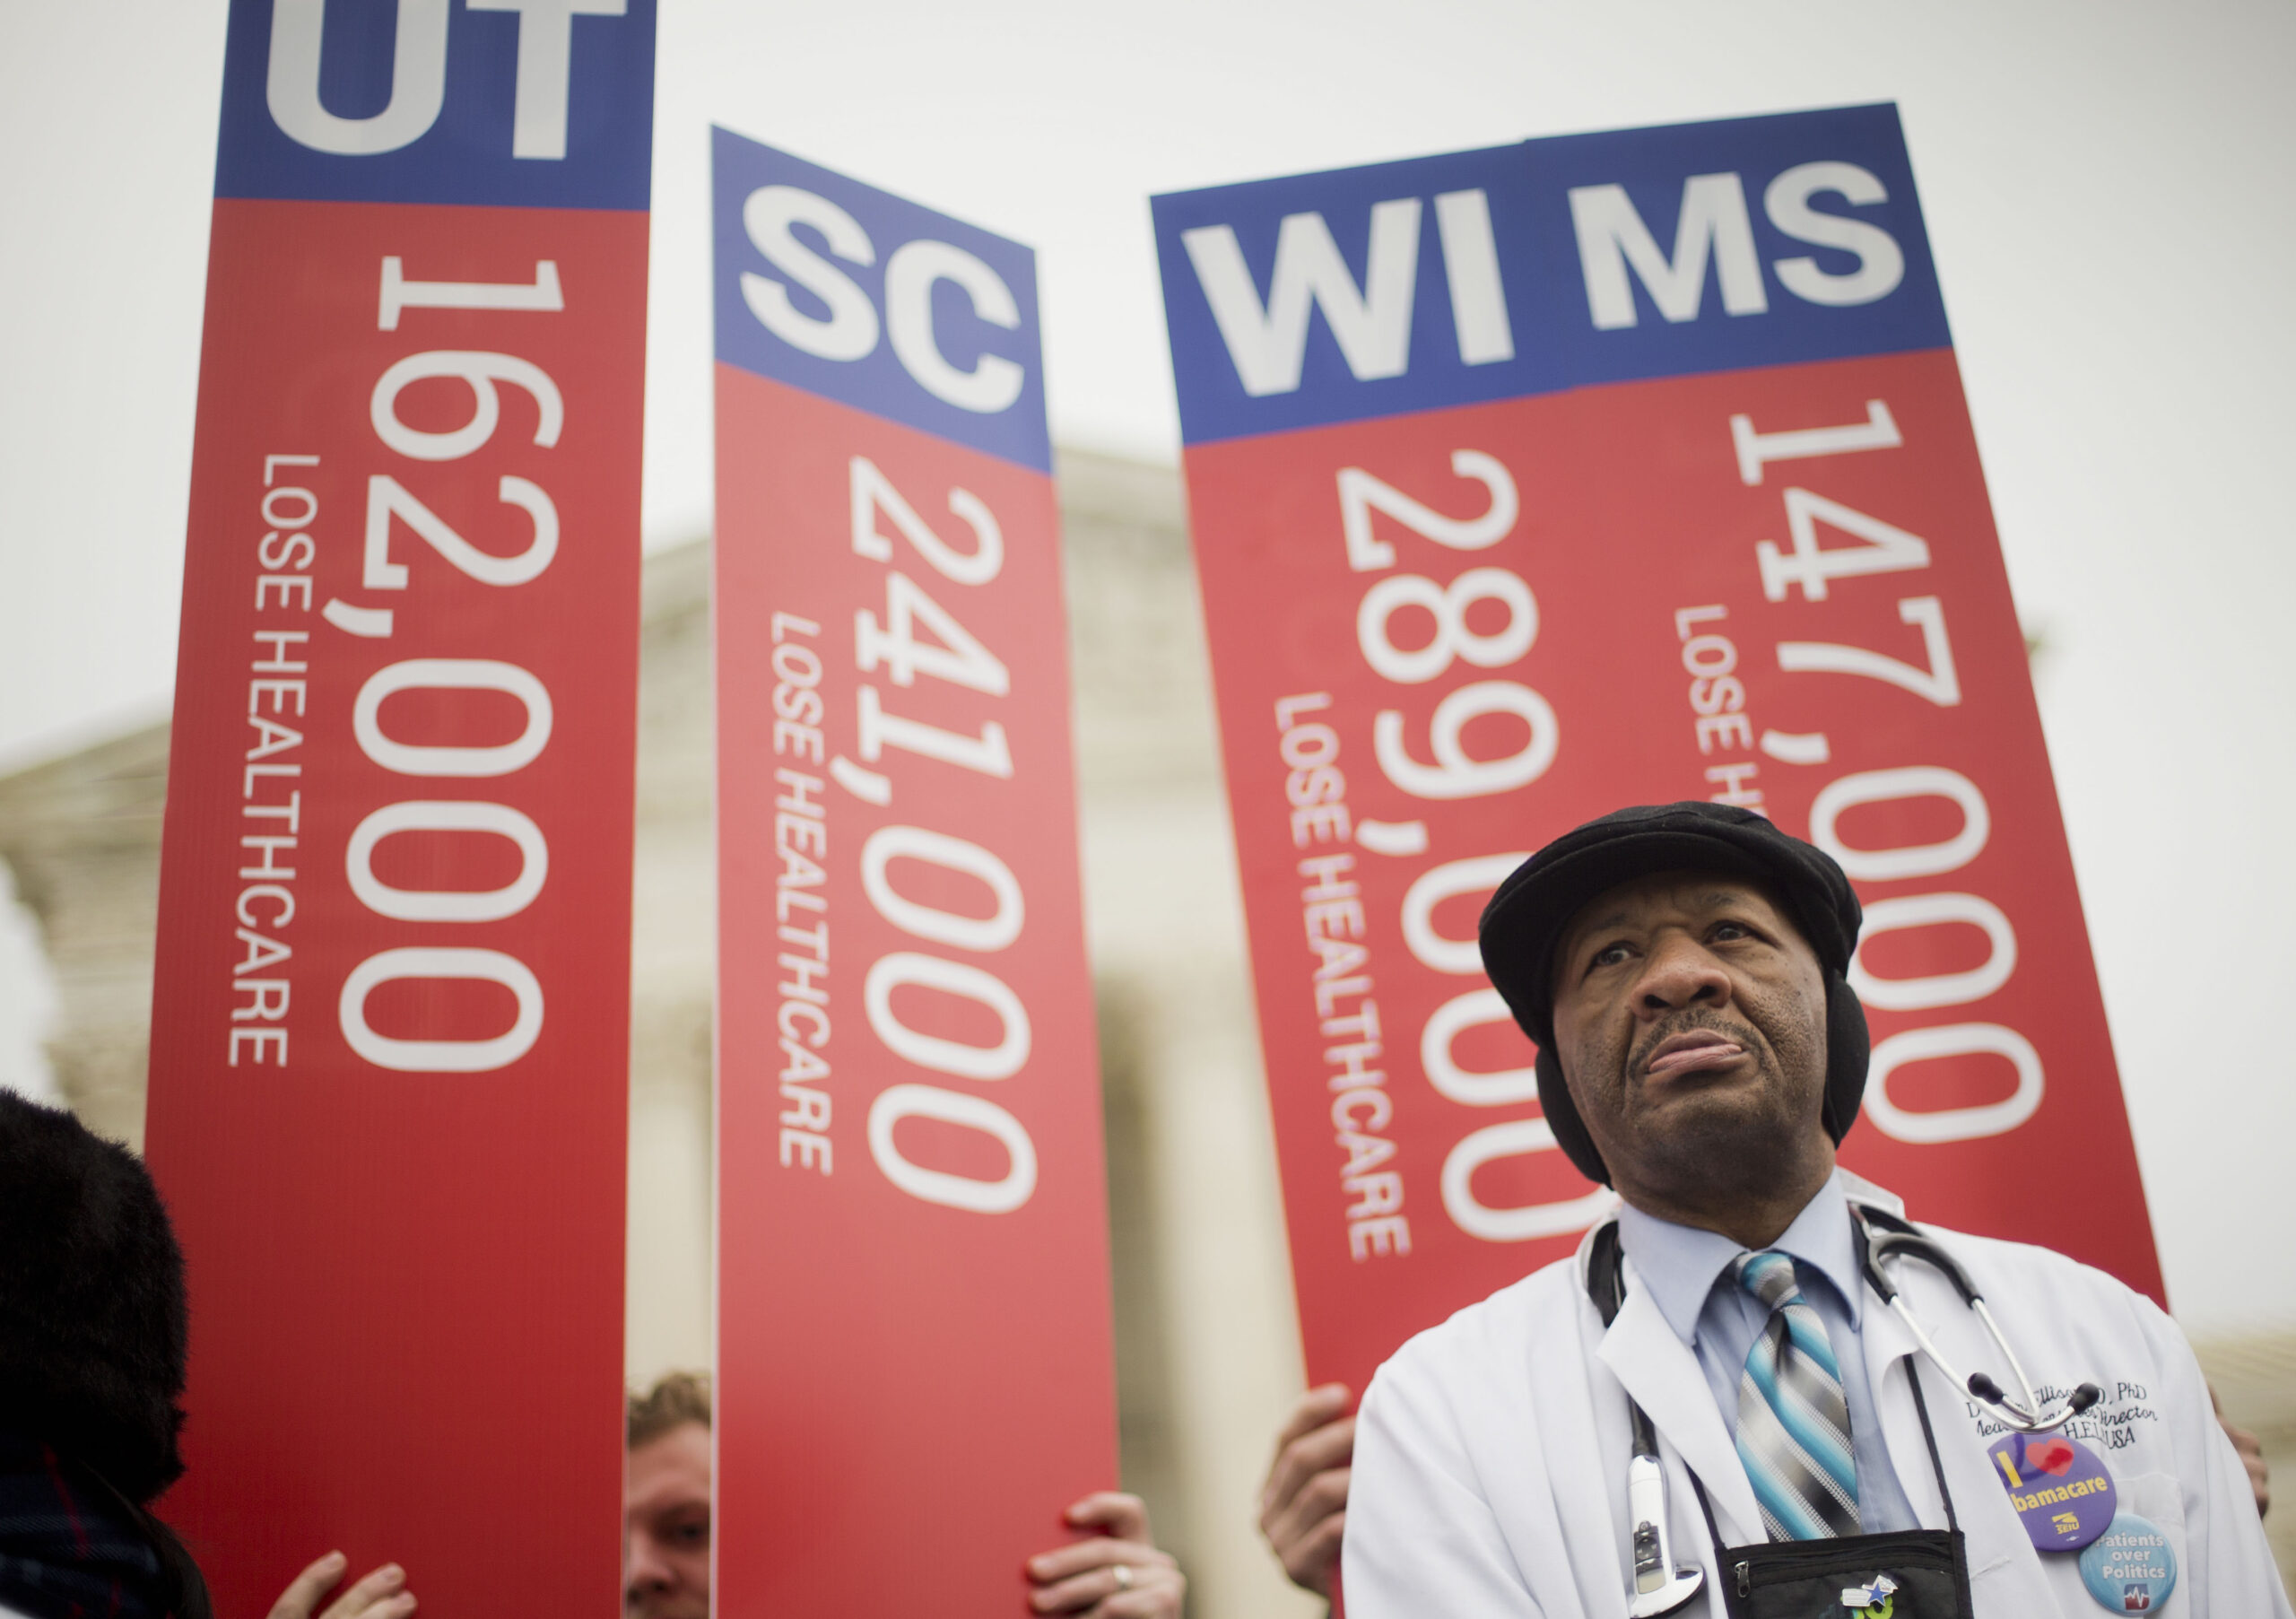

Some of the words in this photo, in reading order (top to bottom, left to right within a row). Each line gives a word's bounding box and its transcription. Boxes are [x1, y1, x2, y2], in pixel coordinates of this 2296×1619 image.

[265, 0, 628, 161] UT
[739, 183, 1026, 415] SC
[1180, 187, 1516, 396] WI
[1567, 160, 1906, 330] MS
[255, 453, 320, 613] LOSE
[321, 256, 566, 1073] 162,000
[770, 610, 825, 766] LOSE
[1674, 604, 1754, 755] LOSE
[228, 630, 309, 1067] HEALTHCARE
[829, 455, 1039, 1215] 241,000
[1274, 692, 1353, 847] LOSE
[1729, 398, 2046, 1145] 147,000
[774, 766, 834, 1176] HEALTHCARE
[1298, 851, 1412, 1263] HEALTHCARE
[2010, 1476, 2108, 1513] bamacare
[2095, 1532, 2165, 1548] Patients
[2101, 1563, 2166, 1580] Politics
[2111, 1550, 2151, 1562] over
